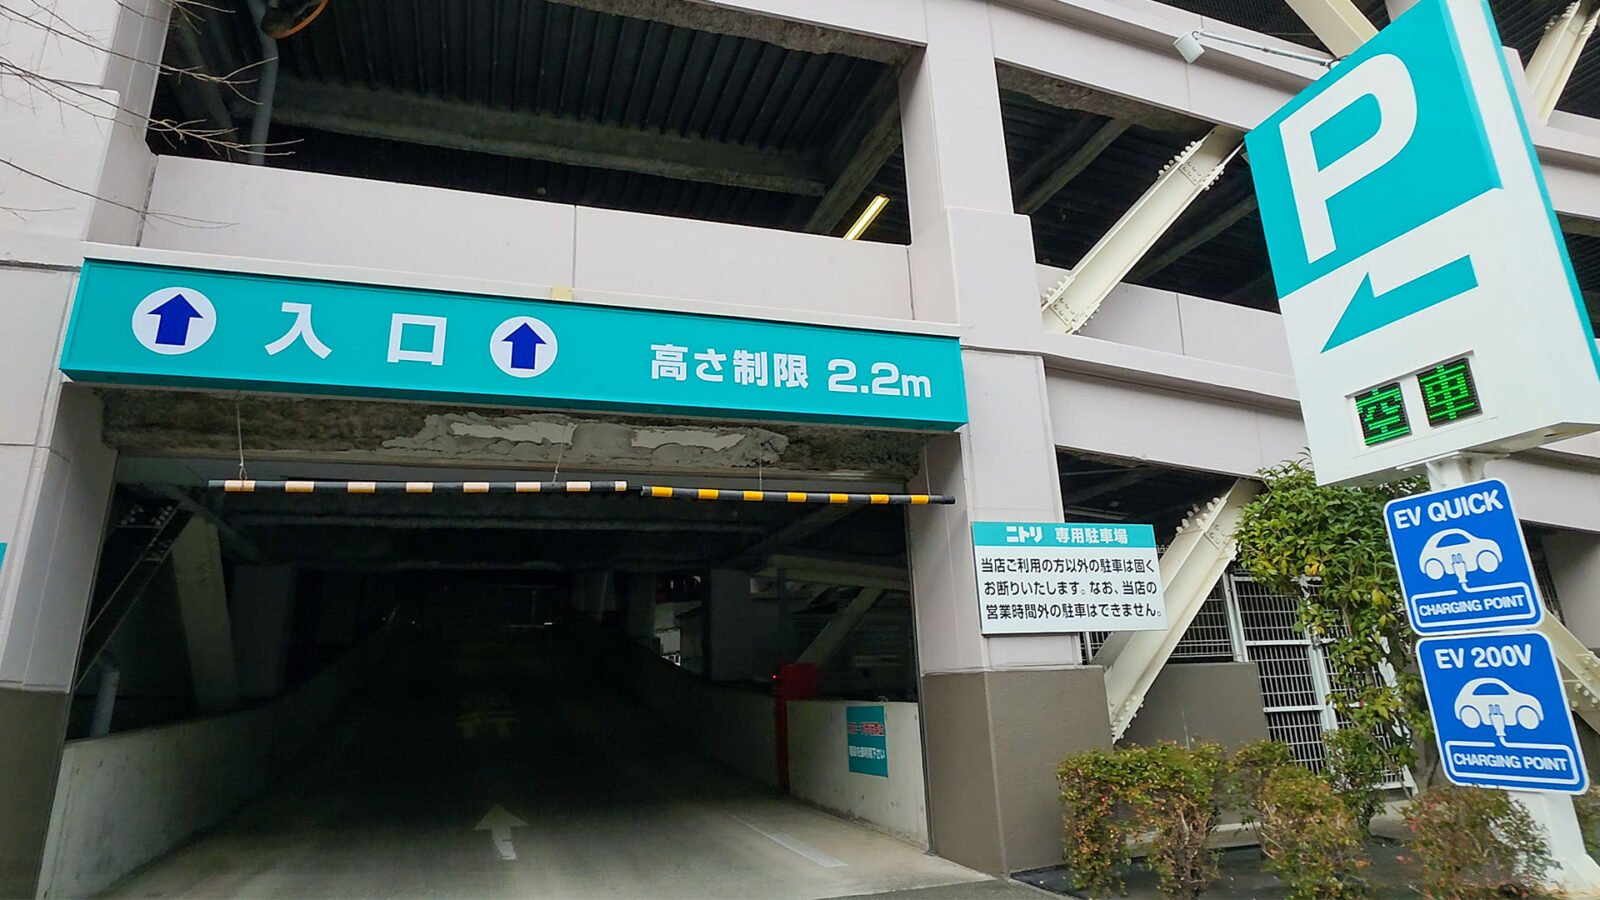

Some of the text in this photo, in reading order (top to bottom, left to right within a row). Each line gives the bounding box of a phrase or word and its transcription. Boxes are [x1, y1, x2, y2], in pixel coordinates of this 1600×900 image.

[1279, 53, 1418, 264] P
[650, 343, 932, 398] 高さ制限 2.2m
[1393, 489, 1504, 529] EV QUICK
[1006, 525, 1129, 544] ニトリ 専用駐車場
[980, 557, 1156, 574] 当店ご利用の方以外の駐車は固く
[983, 580, 1158, 597] お断りいたします。なお、当店の
[985, 603, 1162, 621] 営業時間外の駐車はできません。
[1418, 594, 1525, 617] CHARGING POINT
[1434, 643, 1532, 670] EV 200V
[1452, 752, 1568, 771] CHARGING POINT
